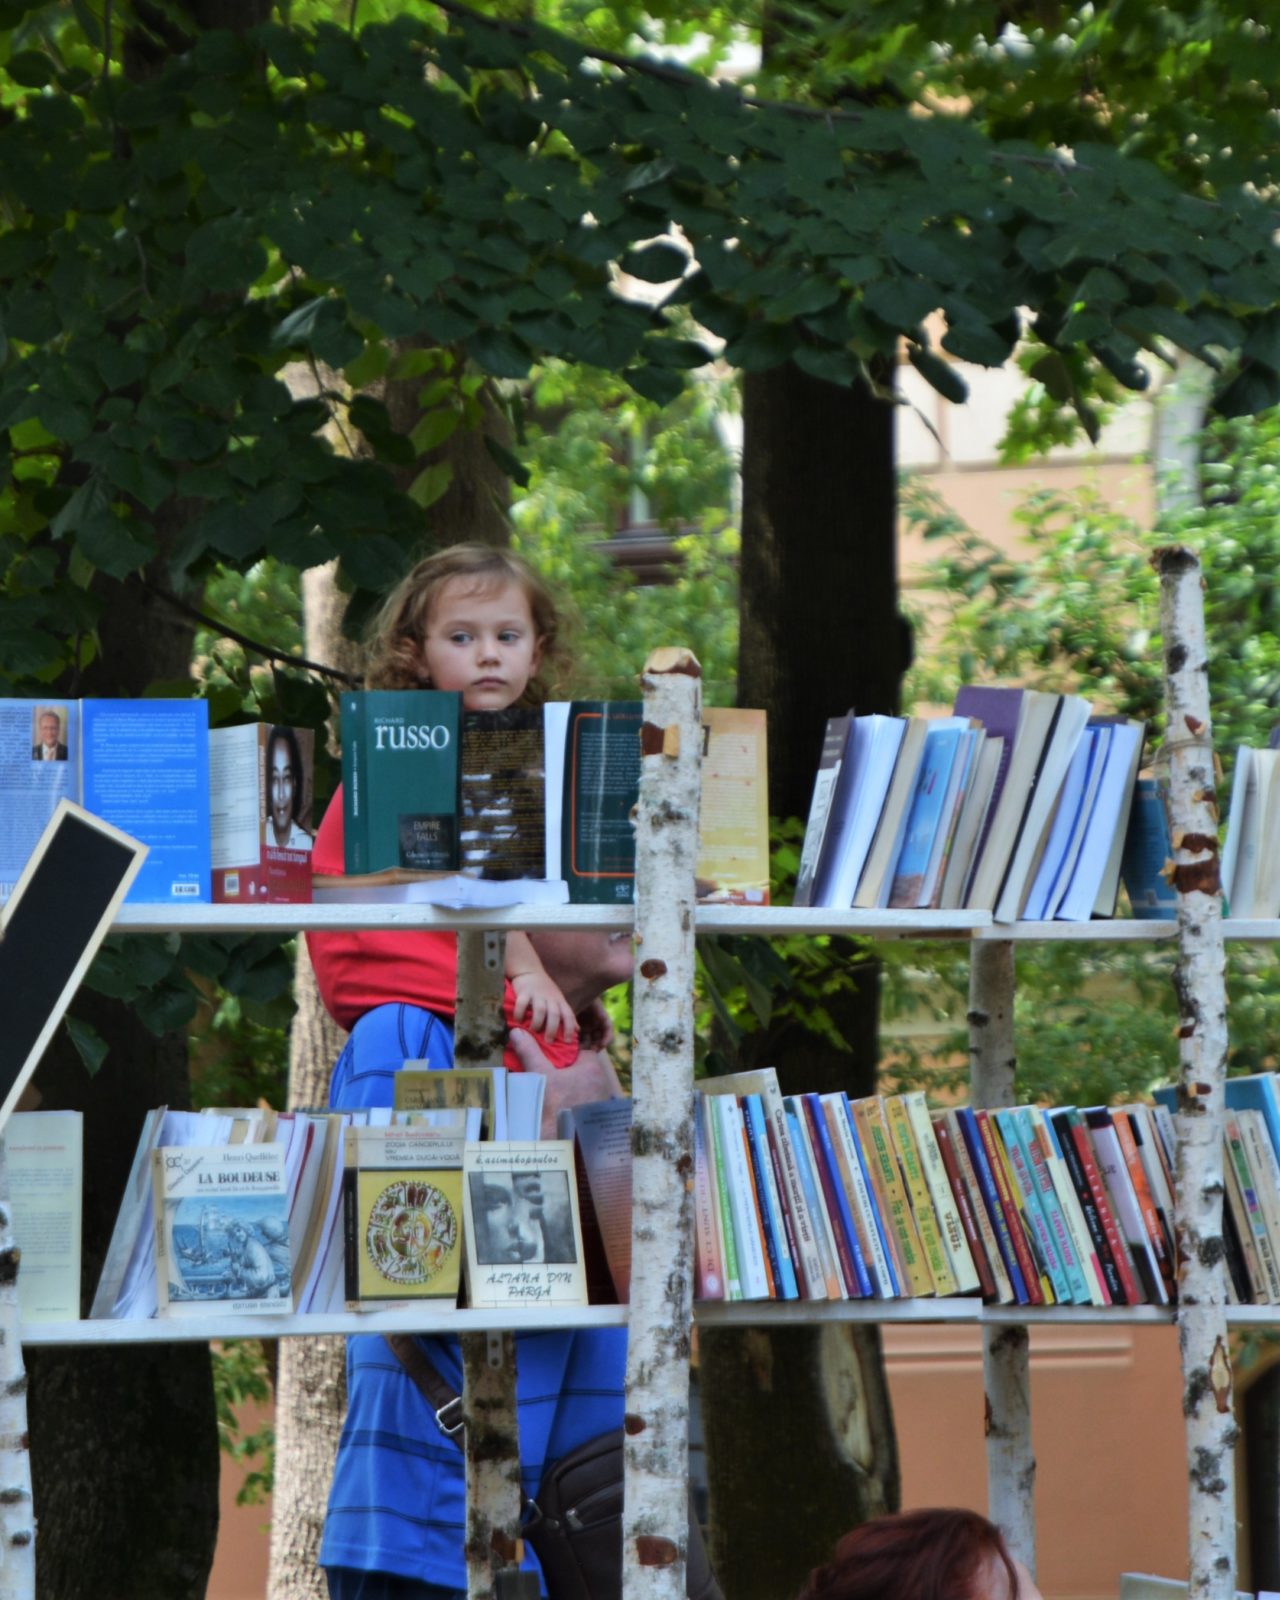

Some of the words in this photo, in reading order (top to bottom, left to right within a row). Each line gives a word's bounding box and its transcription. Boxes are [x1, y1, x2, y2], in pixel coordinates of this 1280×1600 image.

[374, 724, 450, 749] russo
[413, 820, 441, 831] EMPIRE
[416, 832, 438, 841] FALLS
[773, 1108, 787, 1136] Cartea
[222, 1153, 244, 1162] Henri
[198, 1173, 212, 1184] LA
[218, 1171, 280, 1184] BOUDEUSE
[546, 1272, 572, 1284] DIN
